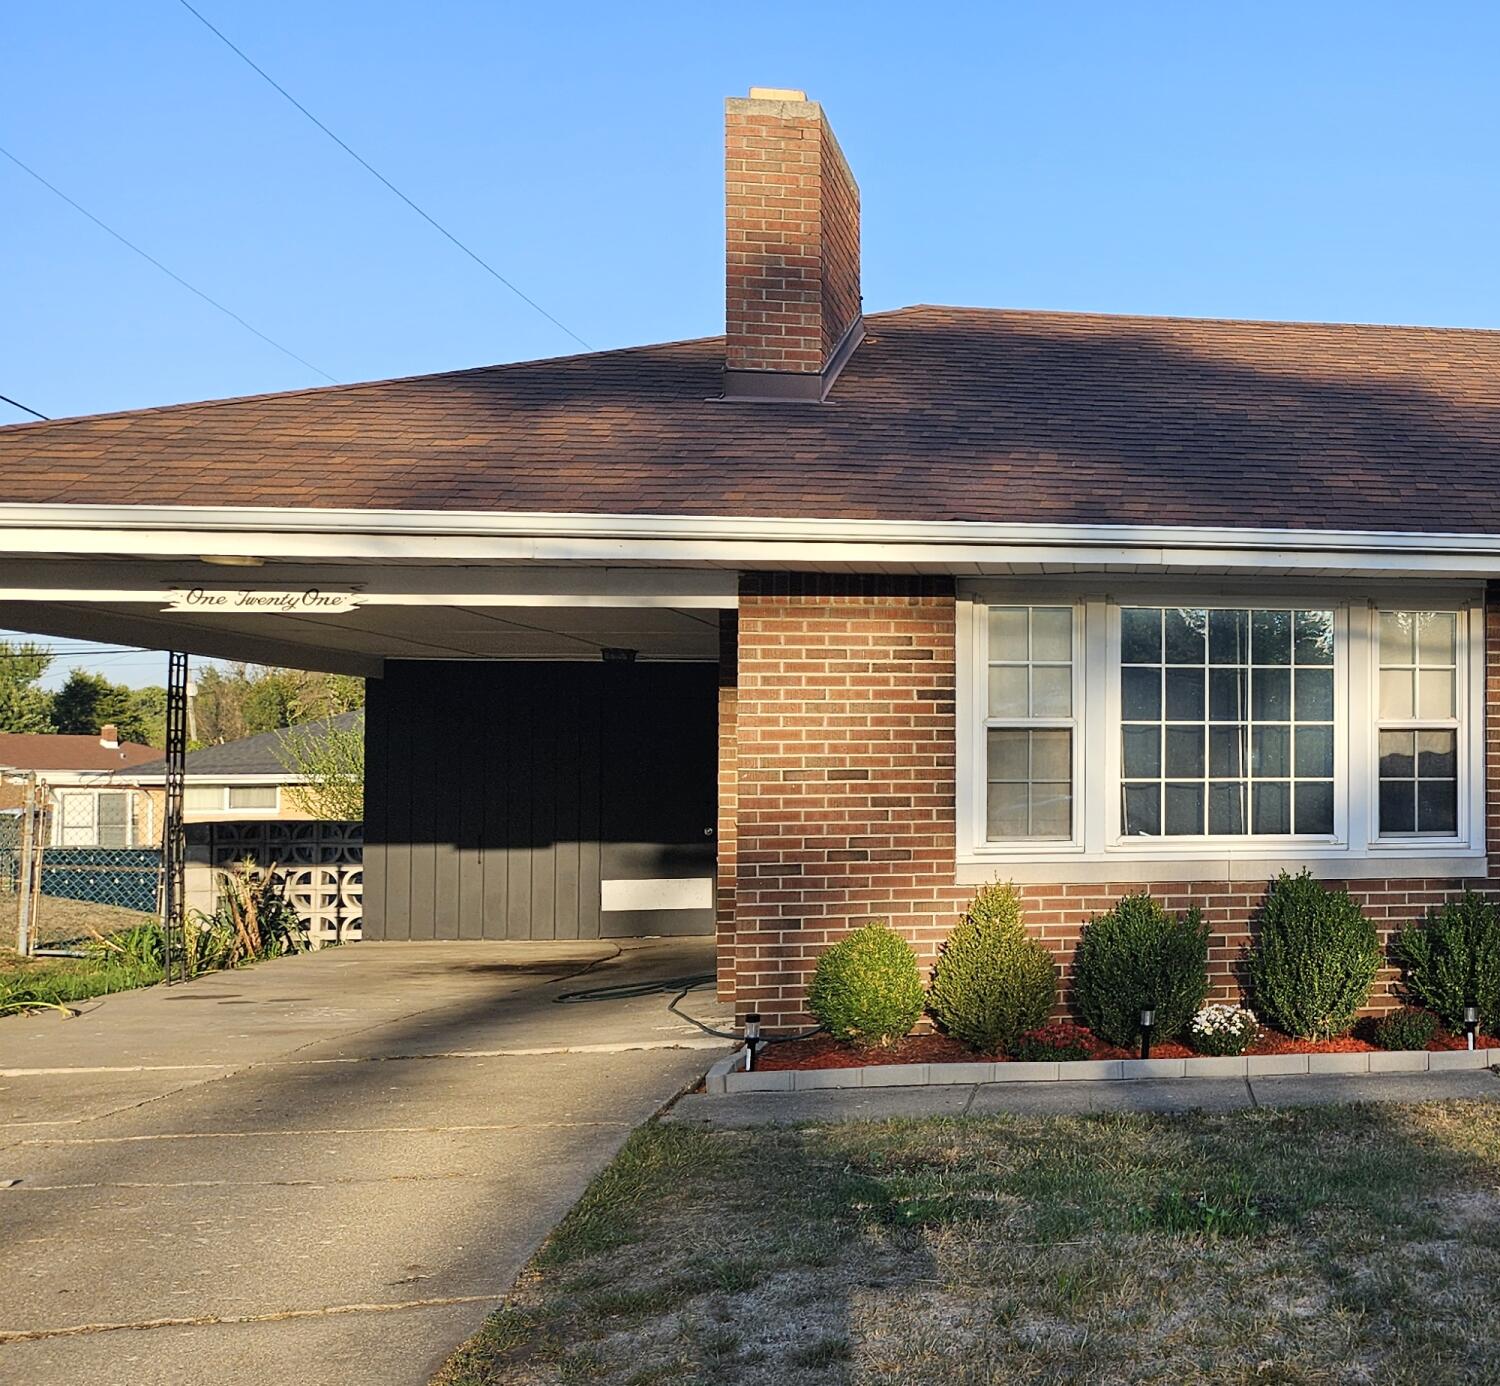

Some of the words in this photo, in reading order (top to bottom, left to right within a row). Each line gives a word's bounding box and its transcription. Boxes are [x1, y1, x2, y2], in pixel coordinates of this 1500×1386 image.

[187, 588, 228, 605] One
[234, 590, 300, 611] Twenty
[302, 588, 343, 606] One
